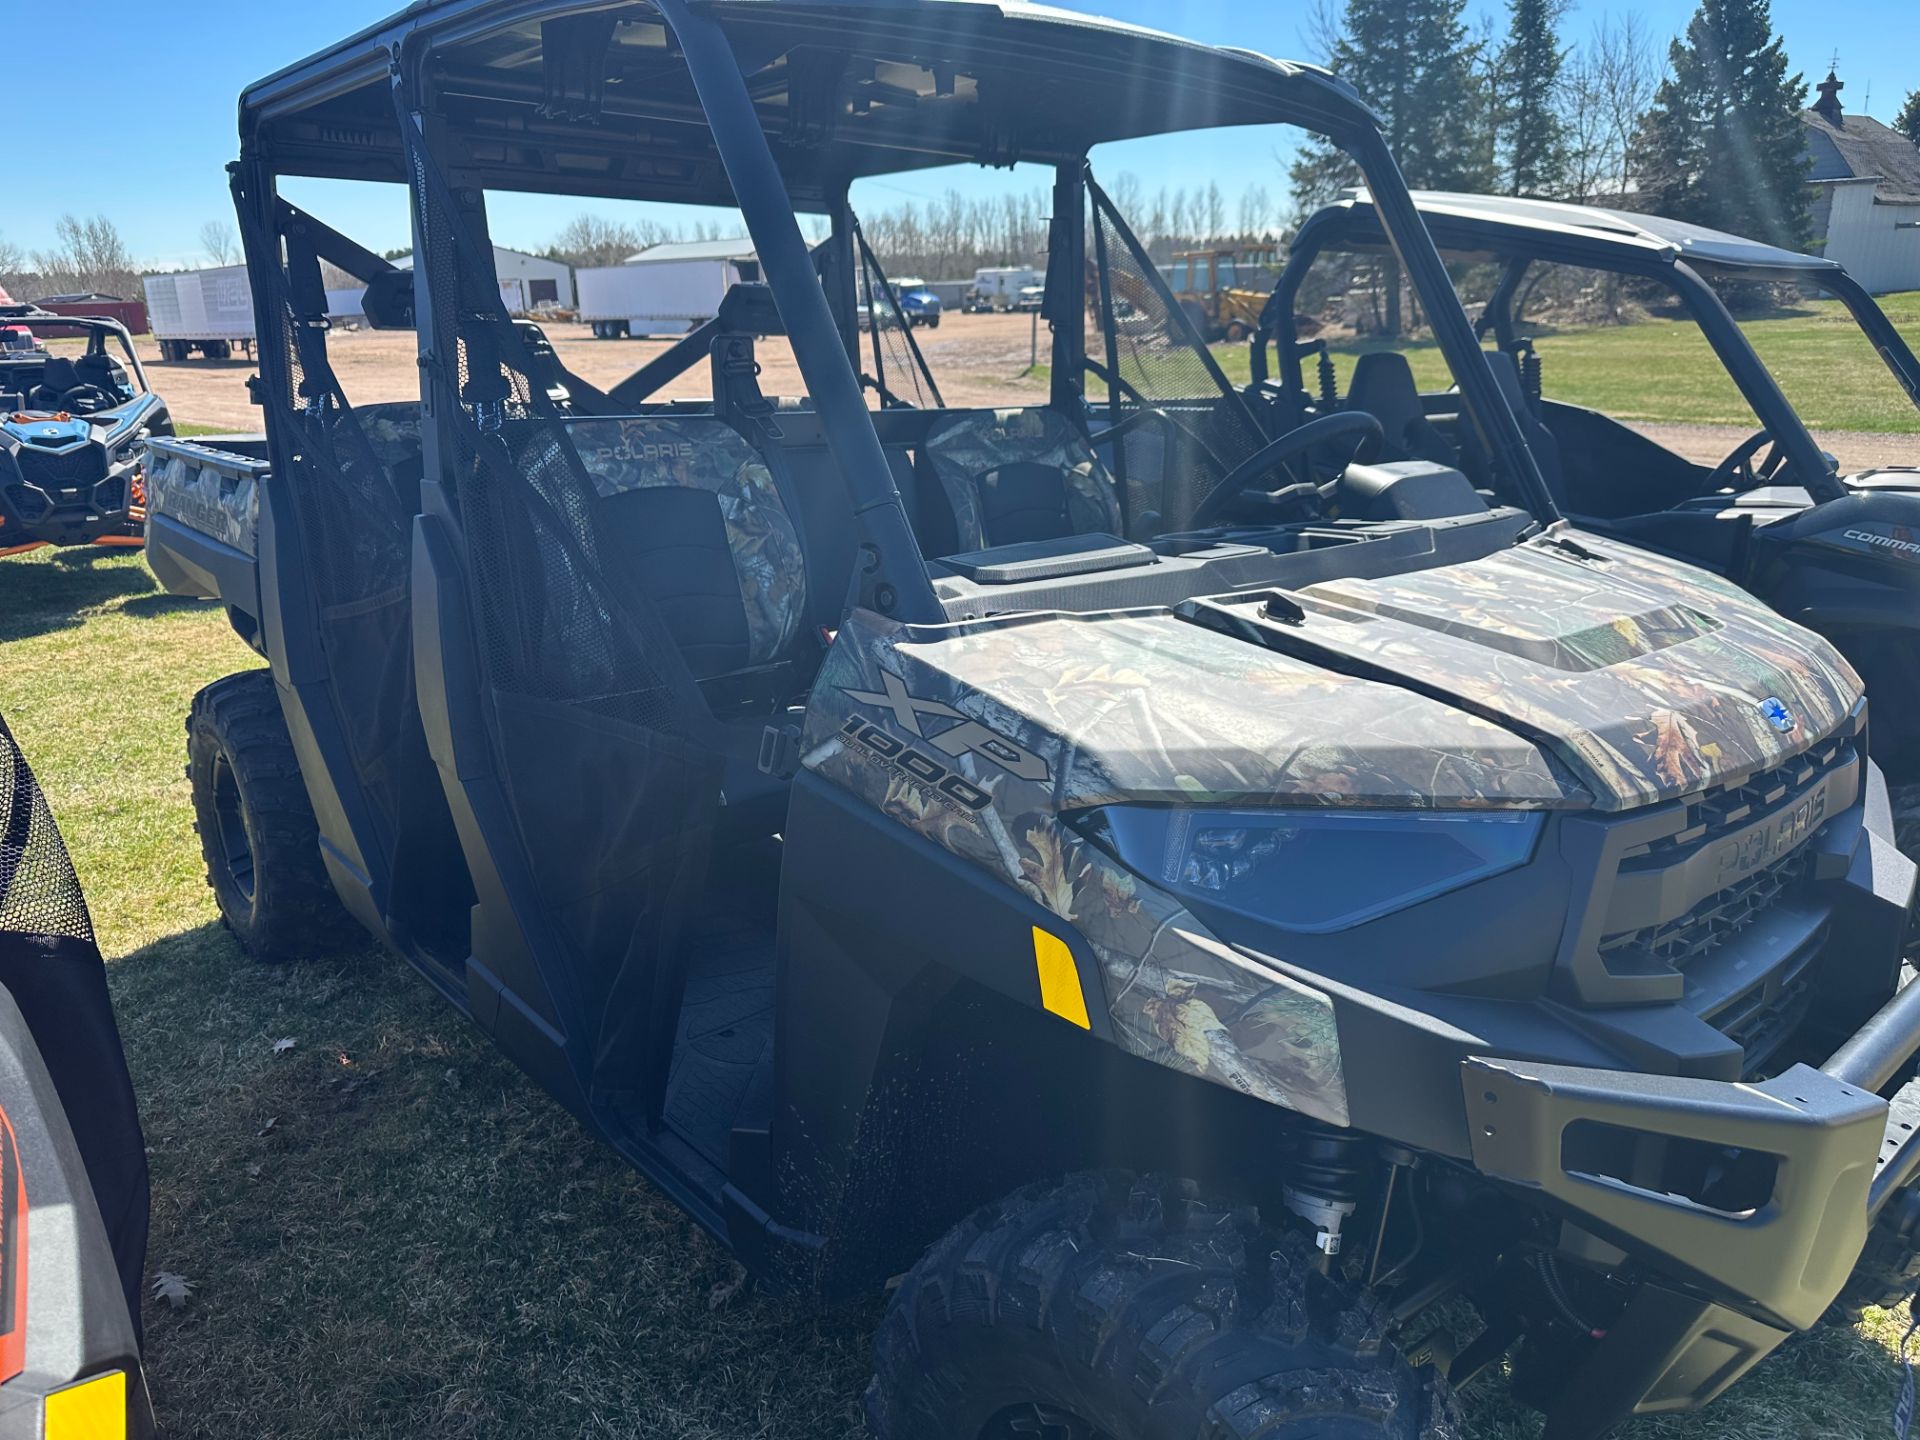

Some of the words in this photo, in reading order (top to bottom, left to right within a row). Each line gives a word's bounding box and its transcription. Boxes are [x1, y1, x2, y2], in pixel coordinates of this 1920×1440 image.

[597, 443, 694, 461] POLARIS
[167, 491, 228, 531] RANGER
[1843, 529, 1920, 553] COMMA
[831, 668, 1050, 782] XP
[839, 713, 993, 813] 1000
[834, 734, 868, 759] DUAL
[870, 755, 943, 803] OVERHEAD
[943, 801, 978, 824] CAM
[1716, 786, 1827, 883] POLARIS
